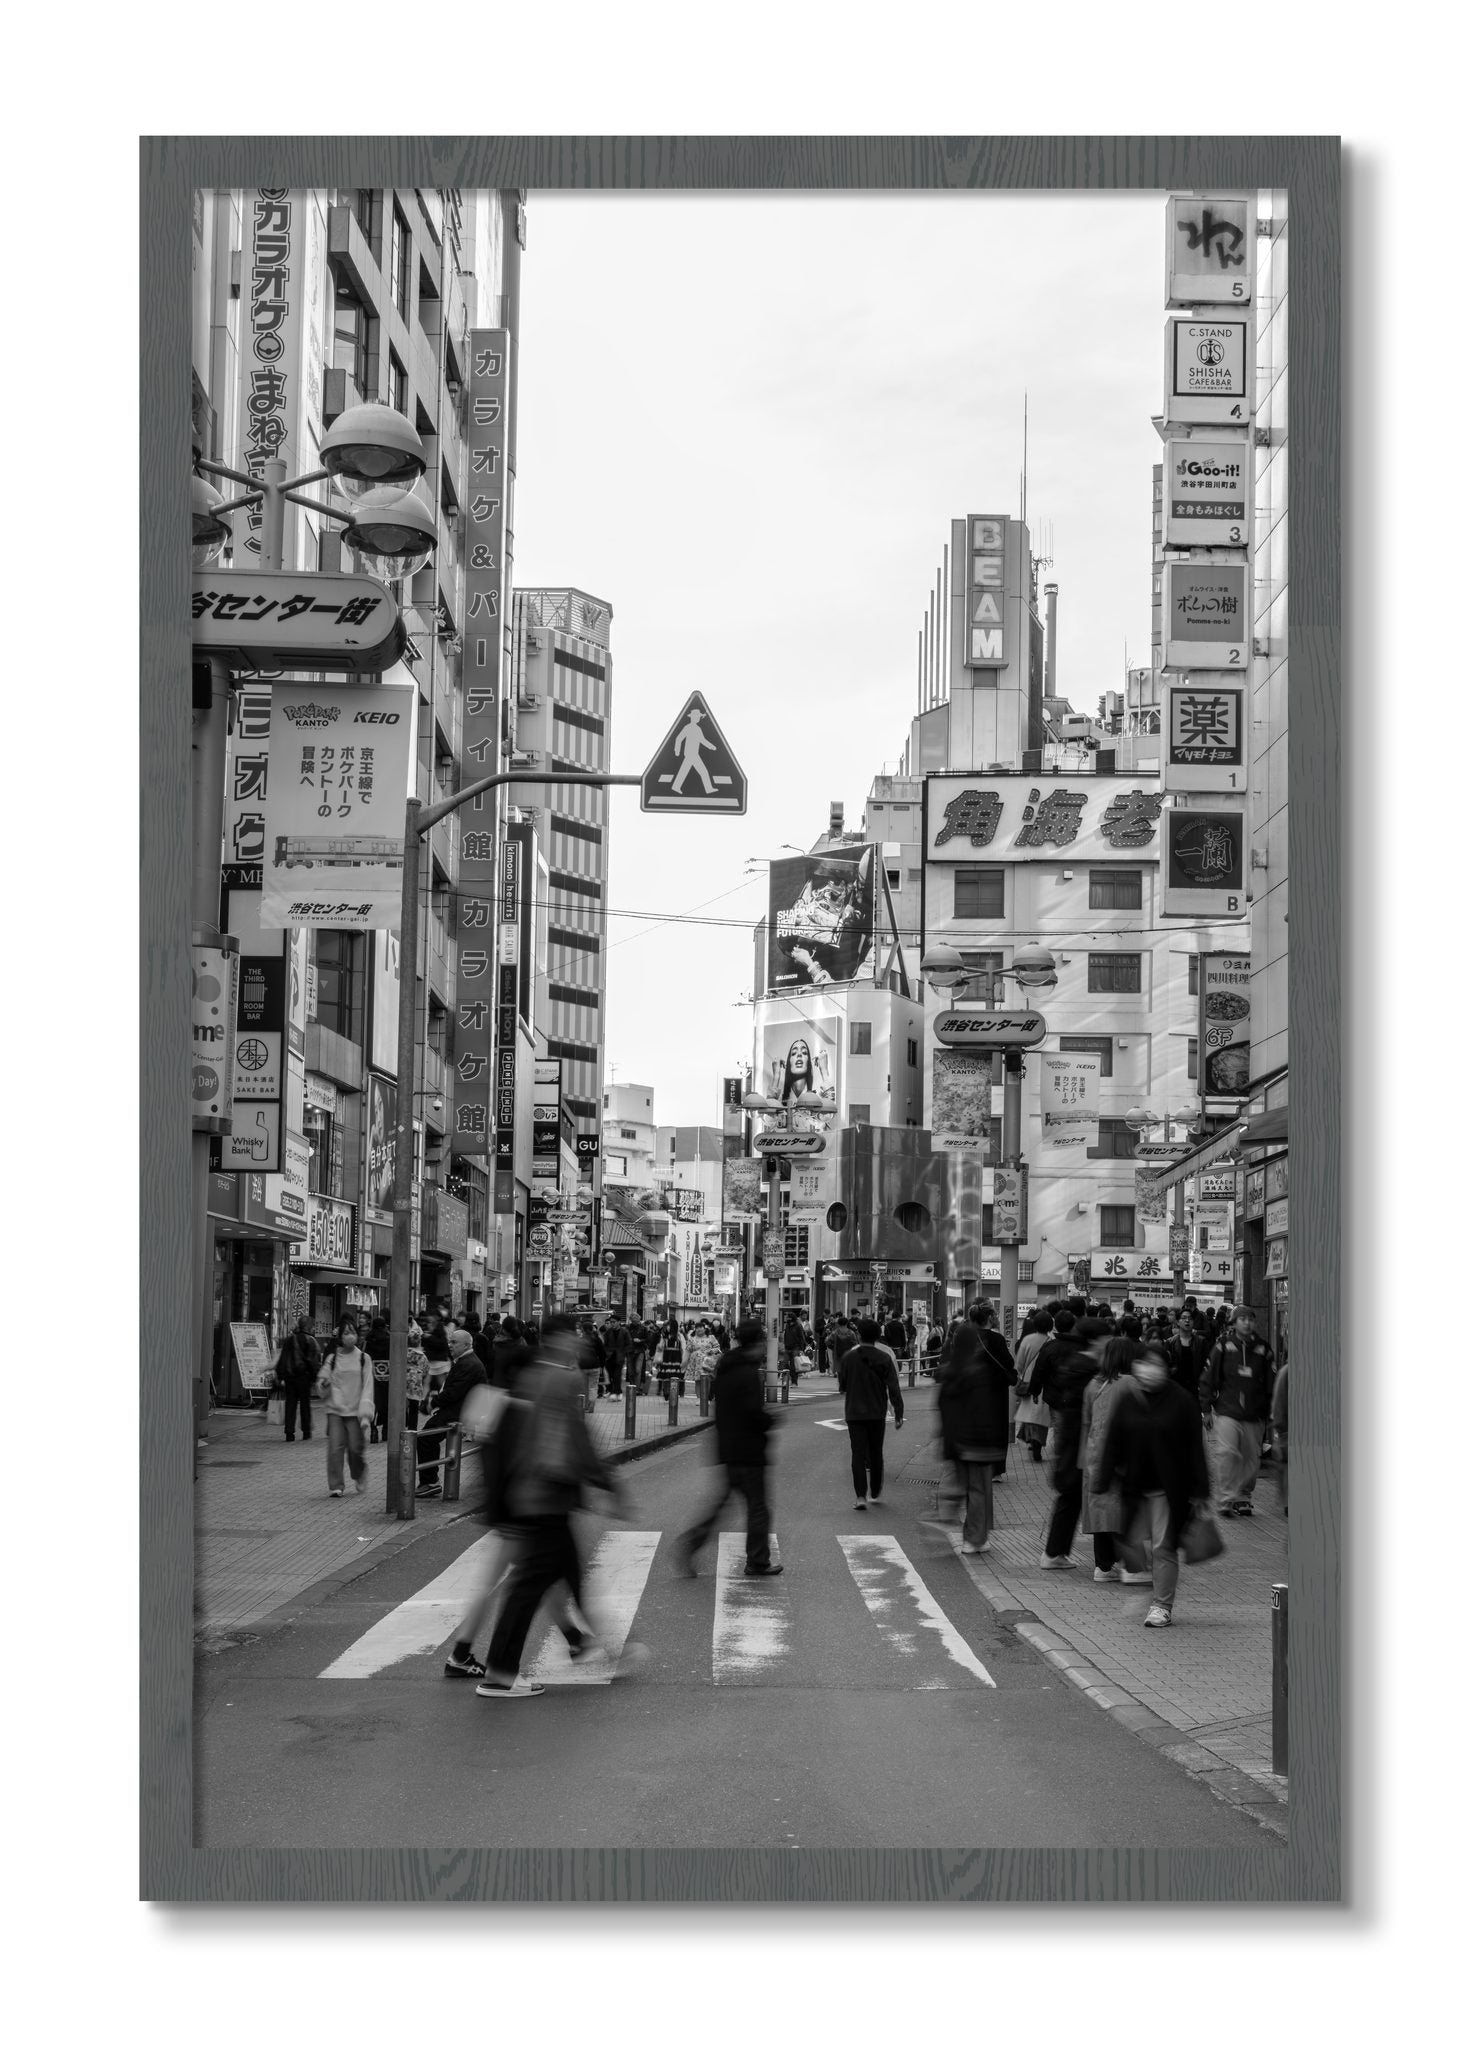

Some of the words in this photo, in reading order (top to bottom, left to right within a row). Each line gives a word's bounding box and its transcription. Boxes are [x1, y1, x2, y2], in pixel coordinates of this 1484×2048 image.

[250, 201, 292, 334] カラオケ
[1231, 283, 1244, 298] 5
[1189, 328, 1233, 338] C.STAND
[1188, 367, 1232, 378] SHISHA
[1188, 378, 1232, 387] CAFE&BAR
[1187, 461, 1240, 477] Goo-it!
[1181, 480, 1237, 490] 渋谷宇田川町店
[1175, 504, 1241, 517] 全身もみほぐし
[1229, 526, 1241, 543] 3
[972, 520, 1004, 659] BEAM
[1229, 648, 1241, 664] 2
[295, 719, 330, 727] KANTO
[353, 711, 401, 726] KEIO
[1180, 695, 1229, 745] 薬
[300, 746, 316, 788] 冒険へ
[317, 746, 336, 818] カントーの
[357, 746, 375, 805] 京王線で
[1228, 772, 1237, 787] 1
[506, 846, 516, 880] kimono
[287, 902, 374, 916] 渋谷センター街
[505, 885, 515, 918] hearts
[1227, 896, 1239, 912] B
[244, 975, 265, 983] THIRD
[243, 1002, 265, 1010] ROOM
[247, 1012, 261, 1020] BAR
[455, 899, 491, 1135] カラオケ館
[940, 1019, 1040, 1033] 渋谷センター街
[1206, 1028, 1234, 1047] 6F
[198, 1075, 217, 1089] Day!
[231, 1136, 265, 1149] Whisky
[578, 1140, 598, 1151] GU
[231, 1146, 251, 1155] Bank
[692, 1253, 701, 1295] BEER
